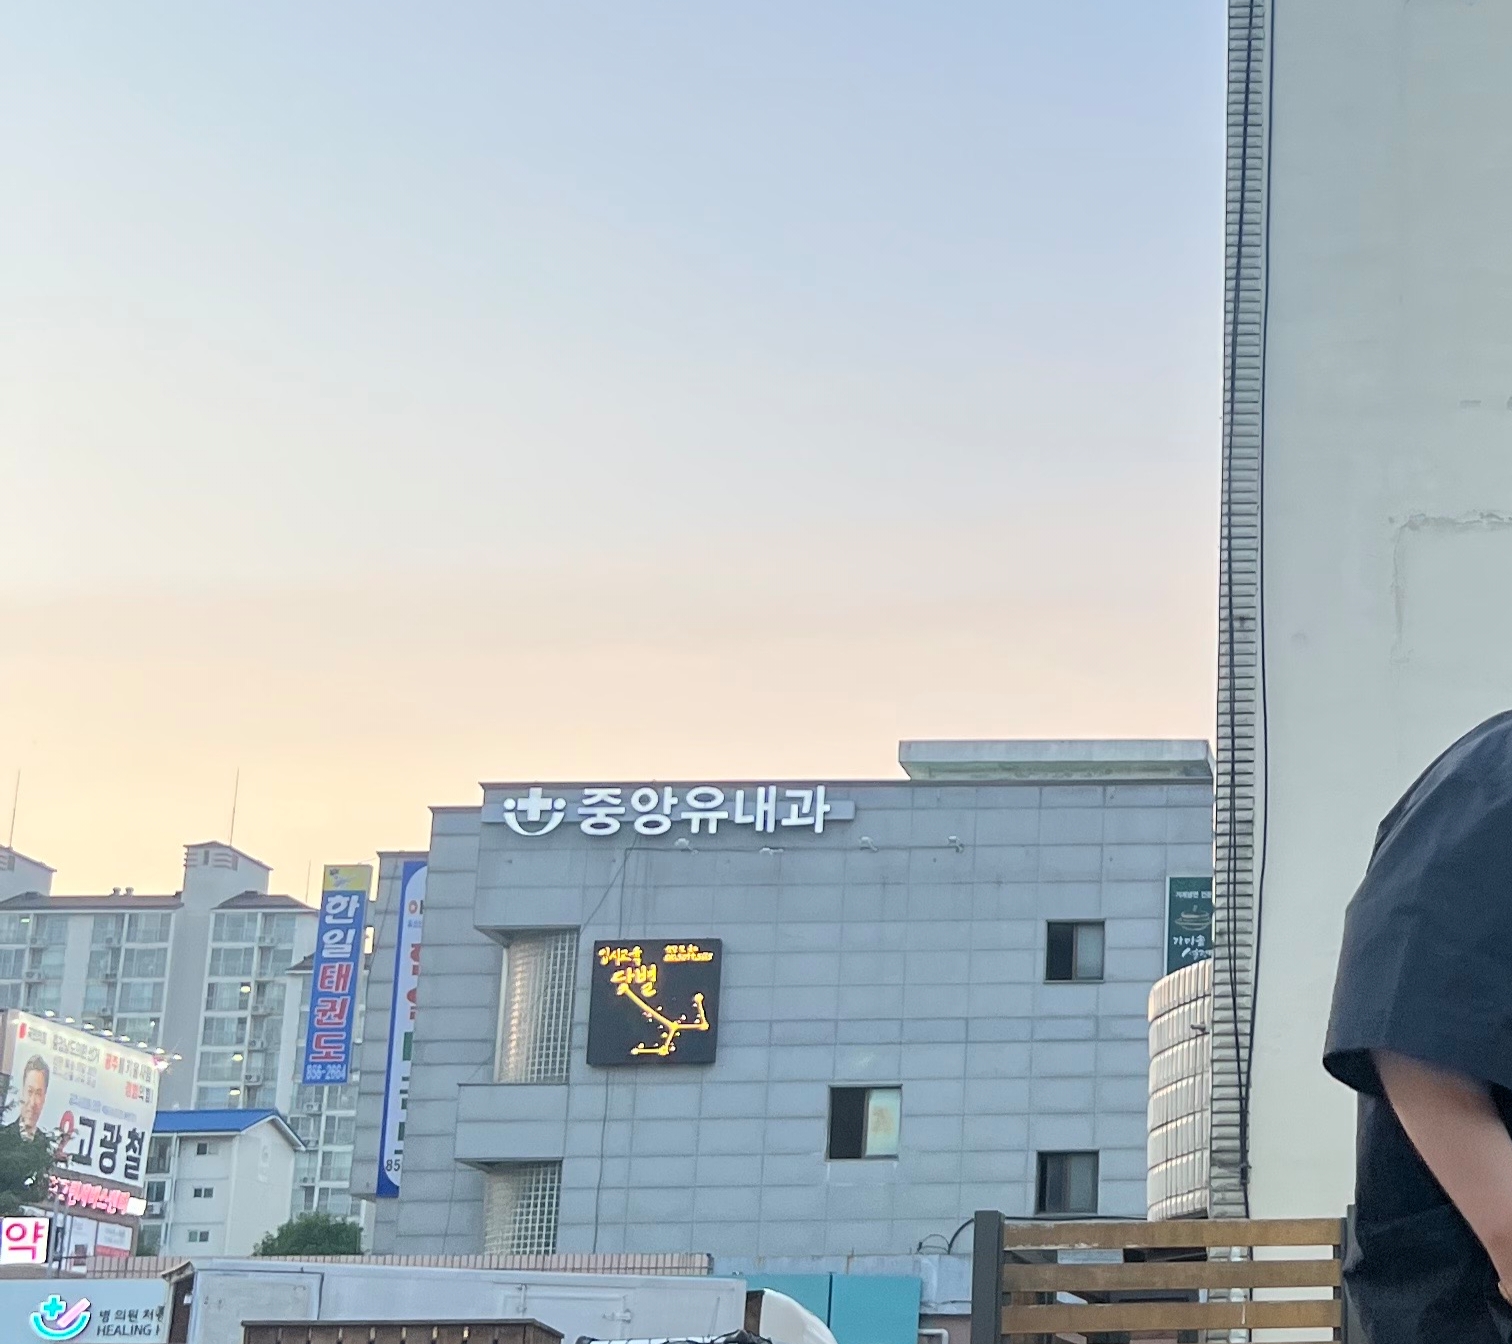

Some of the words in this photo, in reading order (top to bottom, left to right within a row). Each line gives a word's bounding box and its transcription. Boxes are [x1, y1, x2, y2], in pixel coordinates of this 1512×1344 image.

[577, 785, 831, 836] 중앙유내과
[309, 894, 359, 1063] 한일태권도
[71, 1116, 146, 1181] 고광철
[5, 1221, 45, 1260] 약
[96, 1323, 152, 1337] HEALING
